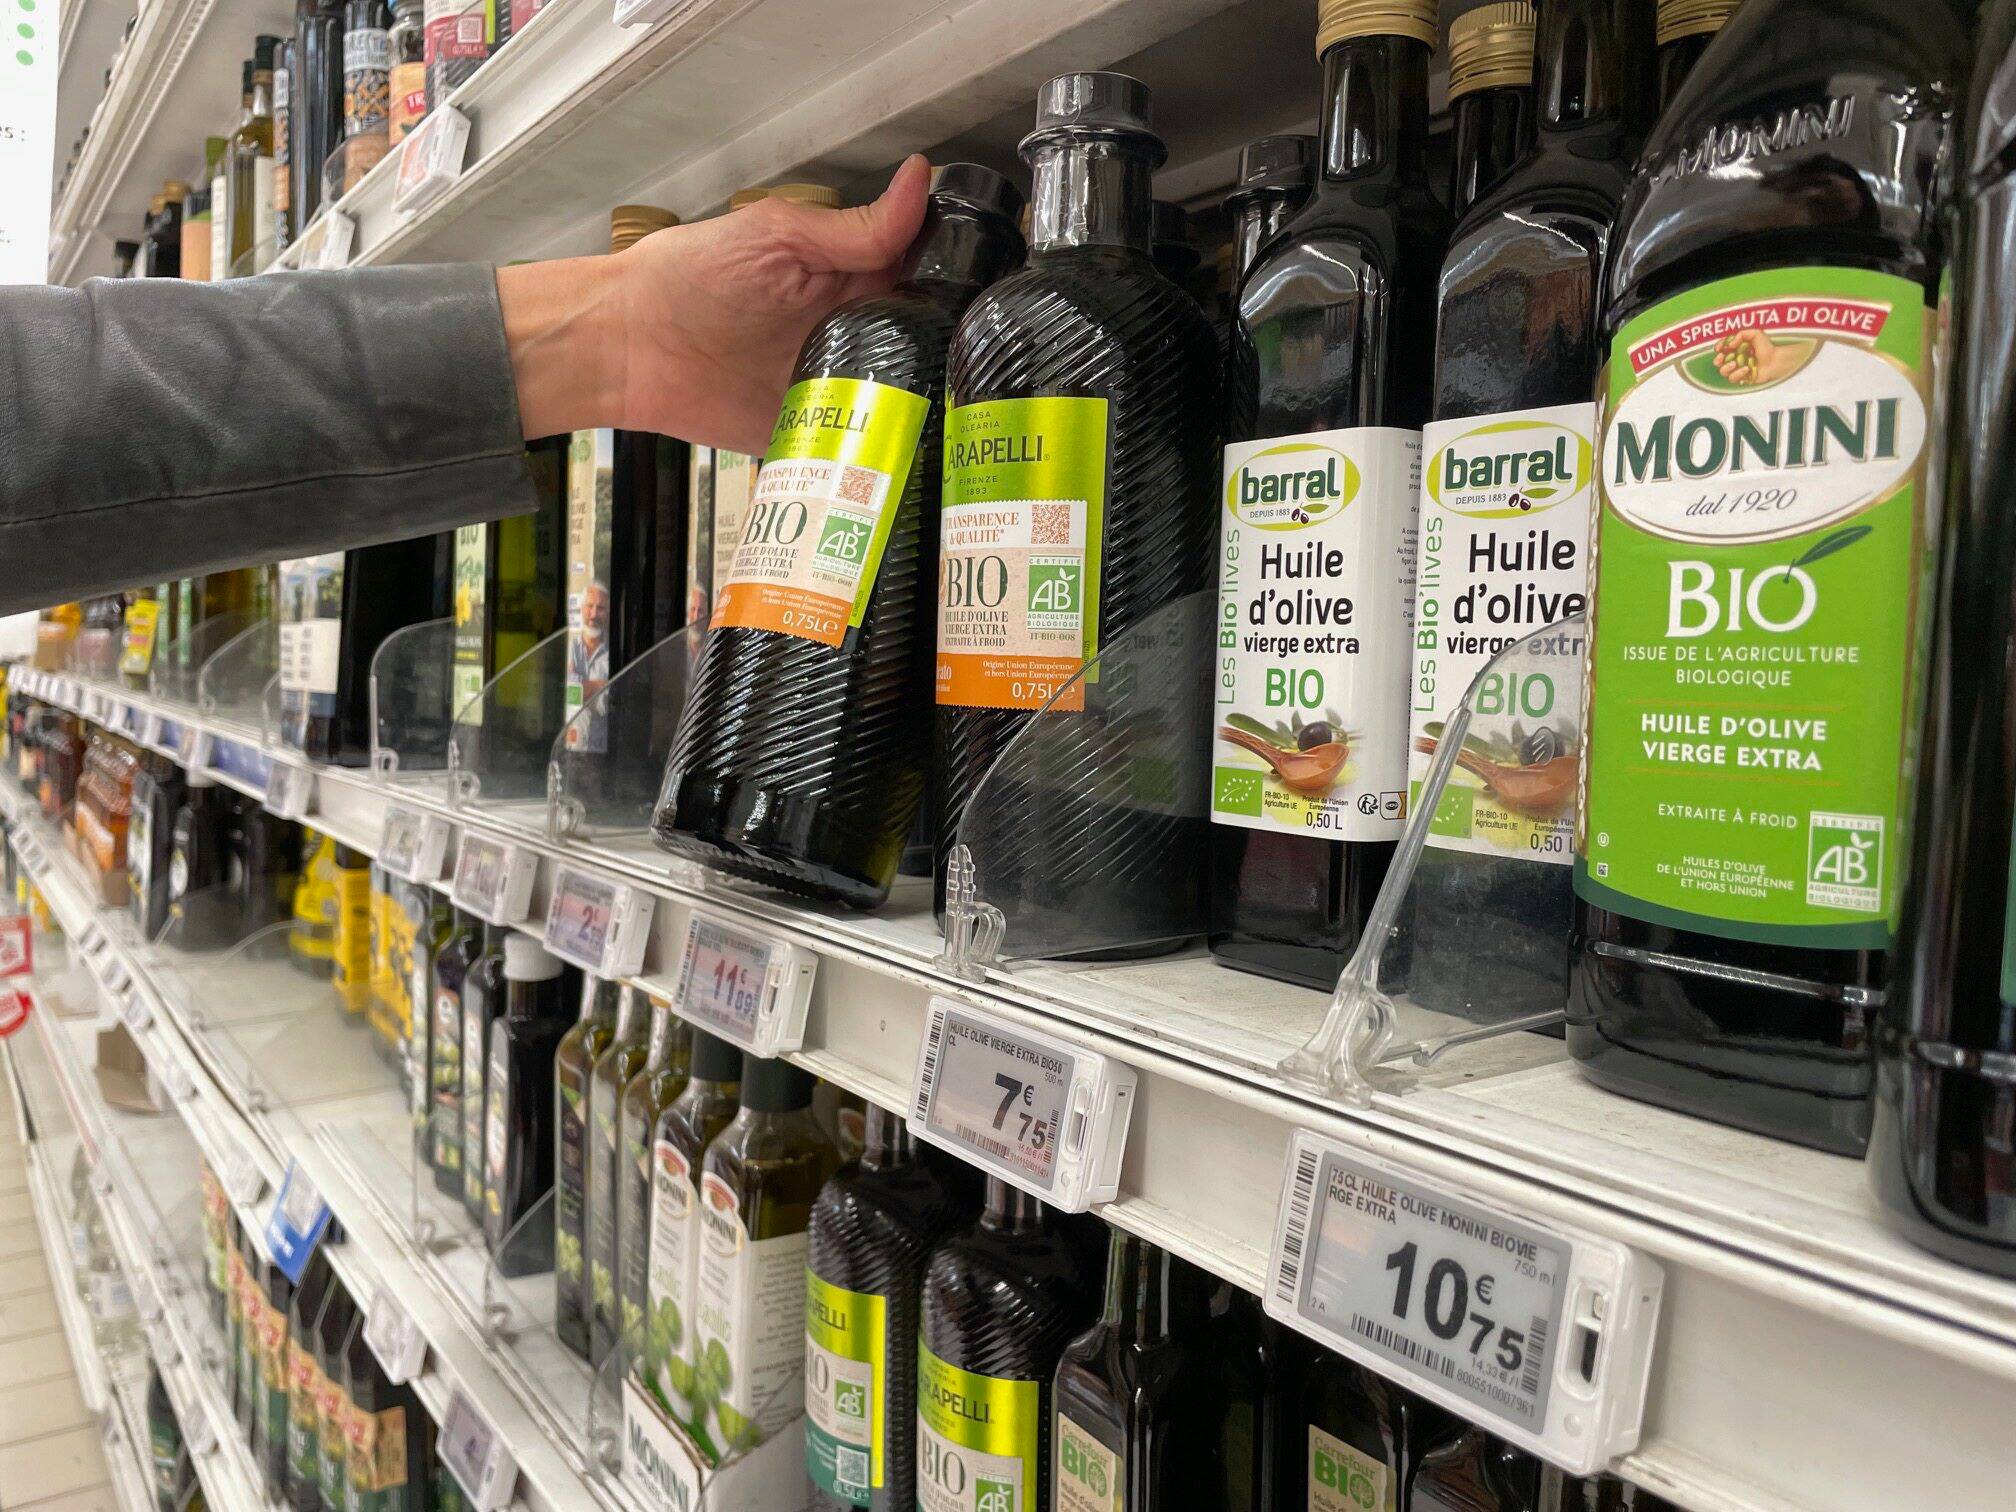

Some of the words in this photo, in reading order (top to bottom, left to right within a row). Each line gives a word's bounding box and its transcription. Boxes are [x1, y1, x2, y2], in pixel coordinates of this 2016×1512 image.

[1636, 341, 1677, 367] UNA
[1680, 309, 1780, 347] SPREMUTA
[1786, 308, 1808, 324] DI
[1813, 307, 1877, 332] OLIVE
[960, 420, 1000, 433] OLEARIA
[966, 411, 991, 421] CASA
[1613, 398, 1902, 488] MONINI
[1444, 436, 1572, 490] barral
[959, 475, 998, 487] FIRENZE
[966, 487, 988, 496] 1893
[1242, 457, 1341, 505] barral
[1456, 495, 1486, 505] DEPUIS
[1489, 493, 1507, 503] 1883
[1685, 494, 1723, 517] dal
[1729, 488, 1798, 514] 1920
[741, 501, 808, 546] BIO
[1250, 509, 1274, 519] DEPUIS
[1276, 508, 1290, 517] 1883
[761, 558, 793, 570] EXTRA
[1261, 541, 1344, 579] Huile
[1469, 530, 1576, 573] Huile
[946, 555, 1009, 608] BIO
[1031, 580, 1072, 611] AB
[1250, 588, 1354, 625] d'olive
[1454, 583, 1586, 624] d'olive
[1665, 560, 1818, 638] BIO
[945, 611, 966, 623] HUILE
[968, 611, 1009, 623] D'OLIVE
[945, 624, 971, 636] VIERGE
[972, 624, 1007, 636] EXTRA
[1027, 613, 1079, 621] AGRICULTURE
[1027, 620, 1079, 628] BIOLOGIQUE
[979, 637, 1006, 648] FROID
[1030, 632, 1076, 642] IT-BIO-008
[1244, 631, 1299, 658] vierge
[1304, 633, 1360, 654] extra
[1528, 633, 1583, 656] extr
[1006, 661, 1028, 669] Union
[1029, 661, 1075, 672] Européenne
[1623, 645, 1667, 662] ISSUE
[1675, 646, 1697, 661] DE
[1705, 645, 1860, 664] L'AGRICULTURE
[1006, 669, 1028, 678] Union
[1218, 657, 1236, 704] Les
[1414, 660, 1436, 711] Les
[1675, 669, 1792, 689] BIOLOGIQUE
[1265, 668, 1325, 710] BIO
[1475, 672, 1555, 717] BIO
[1641, 713, 1710, 735] HUILE
[1721, 716, 1828, 741] D'OLIVE
[1643, 741, 1726, 764] VIERGE
[1737, 747, 1822, 771] EXTRA
[1264, 790, 1290, 800] FR-BIO-10
[1264, 799, 1289, 810] Agriculture
[1306, 812, 1331, 829] 0,50
[1335, 814, 1343, 830] L
[1475, 810, 1508, 820] FR-BIO-10
[1475, 819, 1508, 829] Agriculture
[1658, 804, 1726, 822] EXTRAITE
[1733, 808, 1743, 823] À
[1750, 812, 1798, 828] FROID
[1530, 833, 1562, 854] 0,50
[1656, 863, 1671, 874] DE
[1673, 865, 1716, 880] L'UNION
[1720, 872, 1795, 891] EUROPÉENNE
[1683, 856, 1720, 869] HUILES
[1724, 861, 1767, 875] D'OLIVE
[1680, 878, 1692, 889] ET
[1697, 880, 1726, 893] HORS
[1729, 884, 1767, 898] UNION
[714, 959, 739, 1006] 11
[950, 1021, 969, 1039] HUILE
[970, 1027, 989, 1047] OLIVE
[991, 1034, 1015, 1057] VIERGE
[1016, 1046, 1040, 1066] EXTRA
[993, 1072, 1023, 1131] 7
[1023, 1085, 1035, 1107] €
[1018, 1112, 1048, 1150] 75
[1329, 1184, 1352, 1206] RGE
[1356, 1195, 1397, 1225] EXTRA
[1332, 1168, 1358, 1191] 75CL
[1362, 1180, 1397, 1206] HUILE
[1400, 1196, 1437, 1222] OLIVE
[1441, 1209, 1488, 1243] MONINI
[1514, 1259, 1537, 1279] 750
[1385, 1241, 1468, 1341] 10
[1474, 1274, 1496, 1306] €
[1468, 1312, 1525, 1371] 75
[922, 1431, 966, 1496] BIO
[1314, 1449, 1375, 1509] BIO
